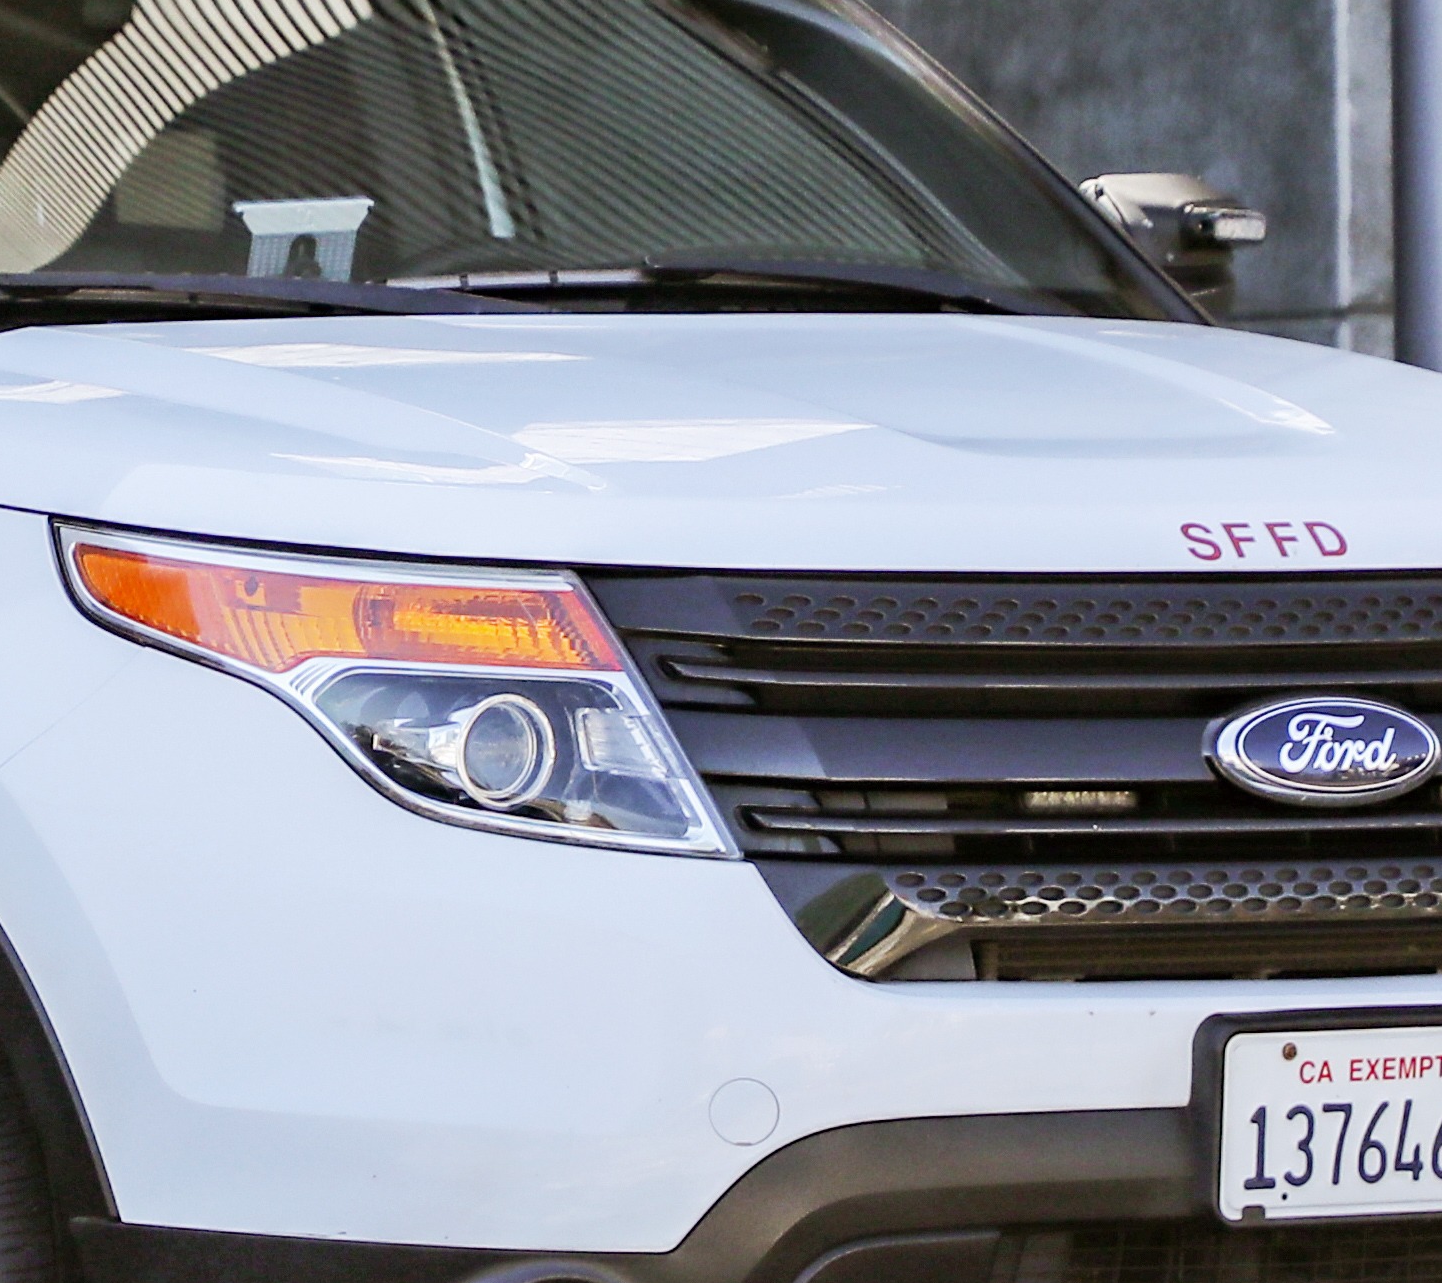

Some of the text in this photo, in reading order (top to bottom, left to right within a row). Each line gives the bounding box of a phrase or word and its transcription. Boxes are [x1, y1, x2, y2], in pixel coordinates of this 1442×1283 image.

[1180, 521, 1348, 561] SFFD
[1279, 712, 1400, 774] Ford
[1299, 1061, 1333, 1084] CA
